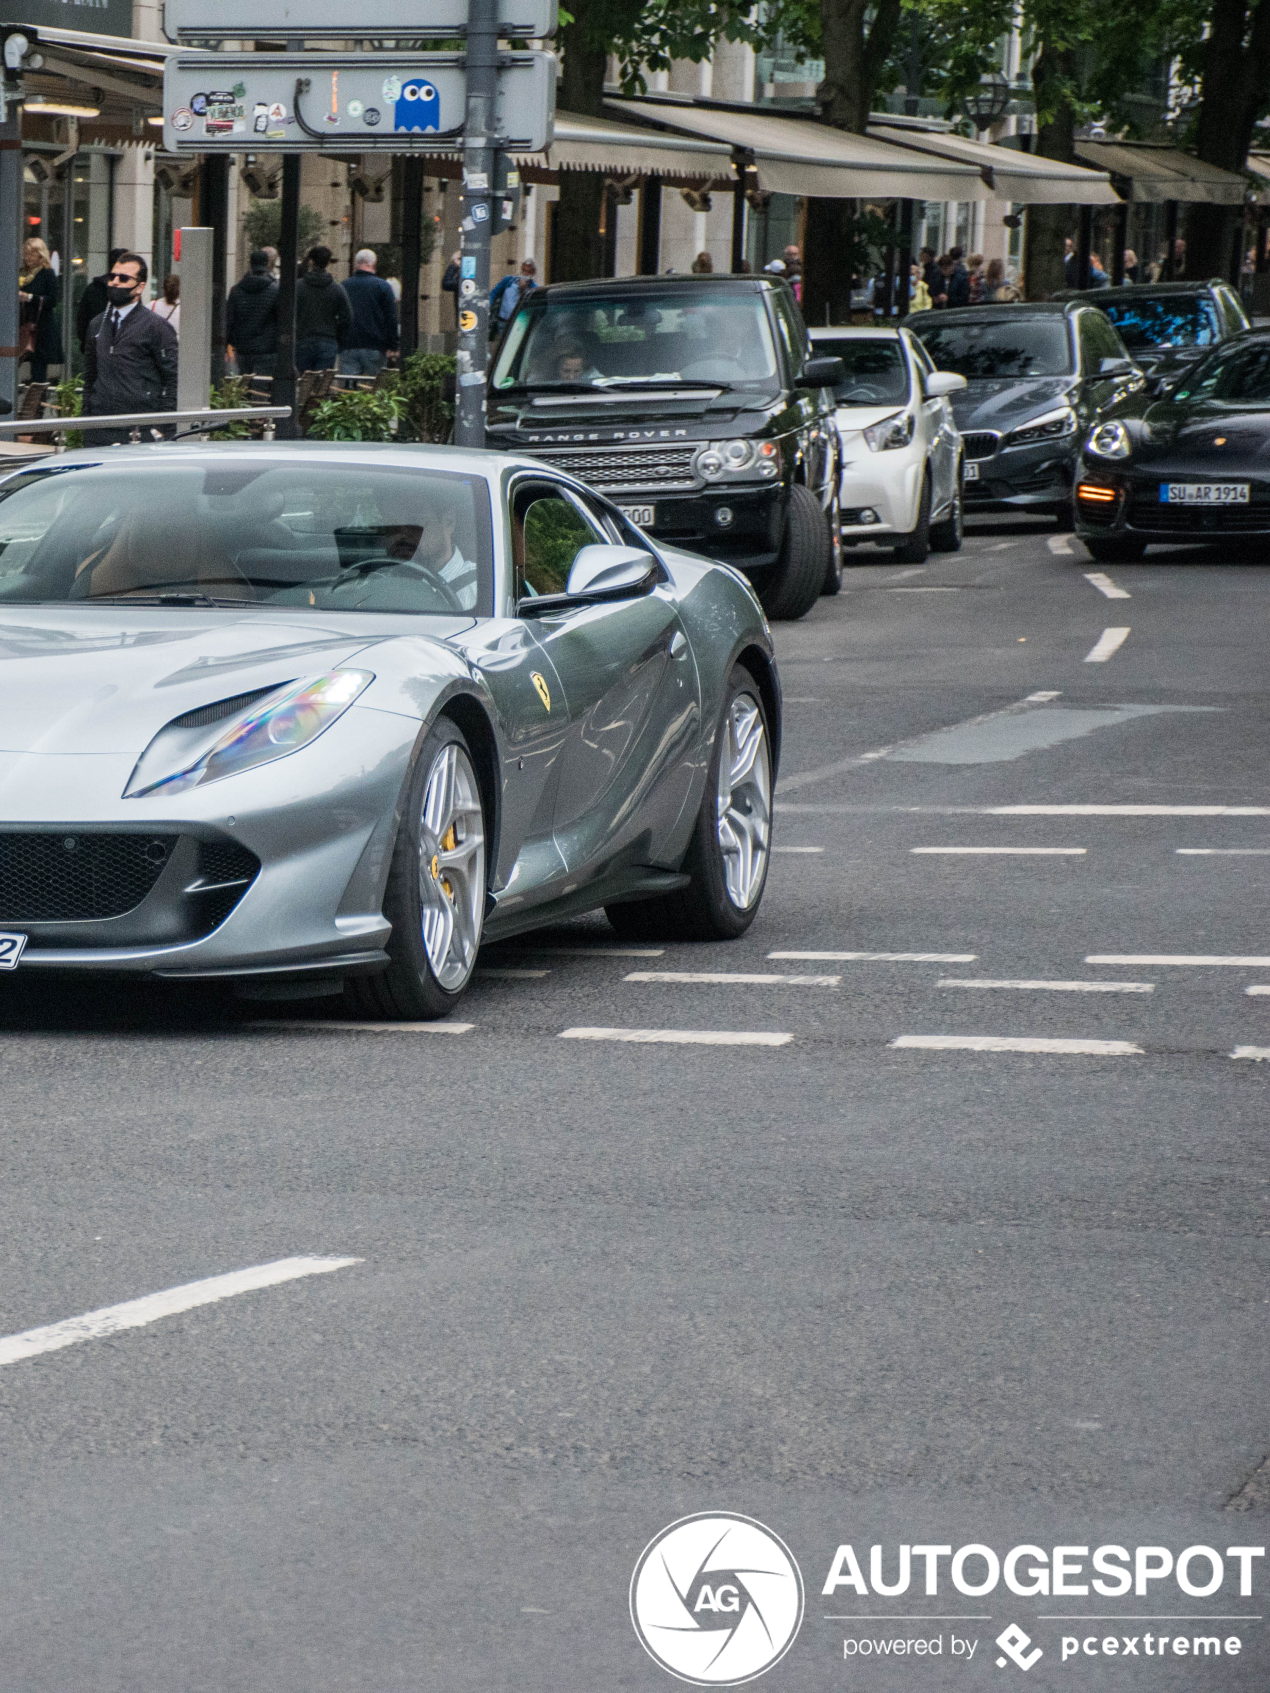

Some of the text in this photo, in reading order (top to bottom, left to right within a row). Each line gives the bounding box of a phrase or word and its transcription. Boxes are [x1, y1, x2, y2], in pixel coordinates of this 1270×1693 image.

[528, 429, 688, 442] RANGE ROVER
[1169, 486, 1247, 500] SU AR 1914
